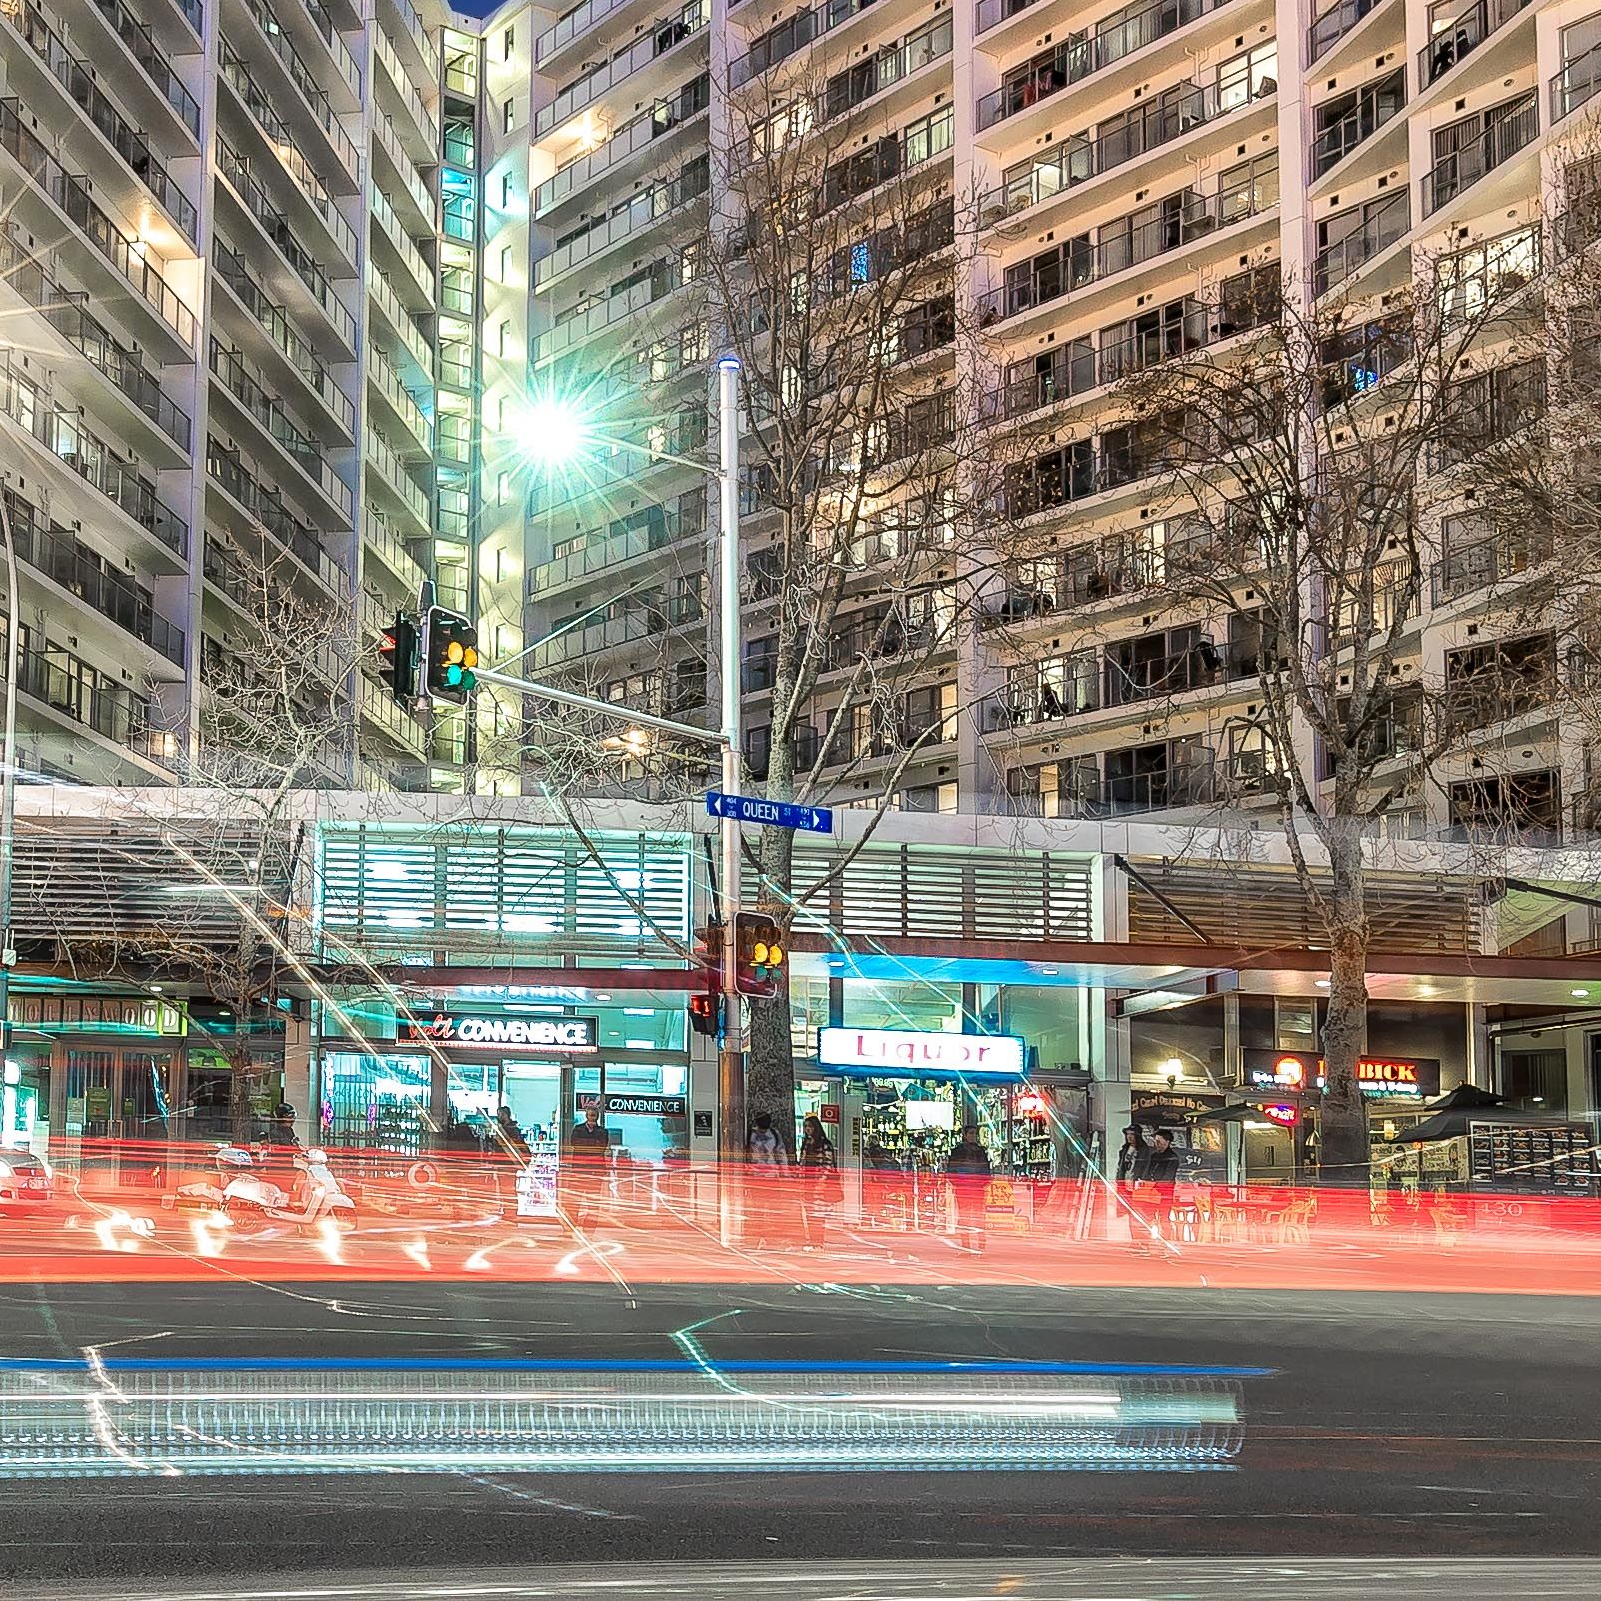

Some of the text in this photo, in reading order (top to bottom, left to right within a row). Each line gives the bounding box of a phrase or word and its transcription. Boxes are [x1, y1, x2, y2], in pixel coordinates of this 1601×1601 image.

[742, 801, 779, 821] QUEEN
[458, 1017, 588, 1045] CONVENIENCE
[580, 1095, 680, 1113] Vol CONVENIENCE
